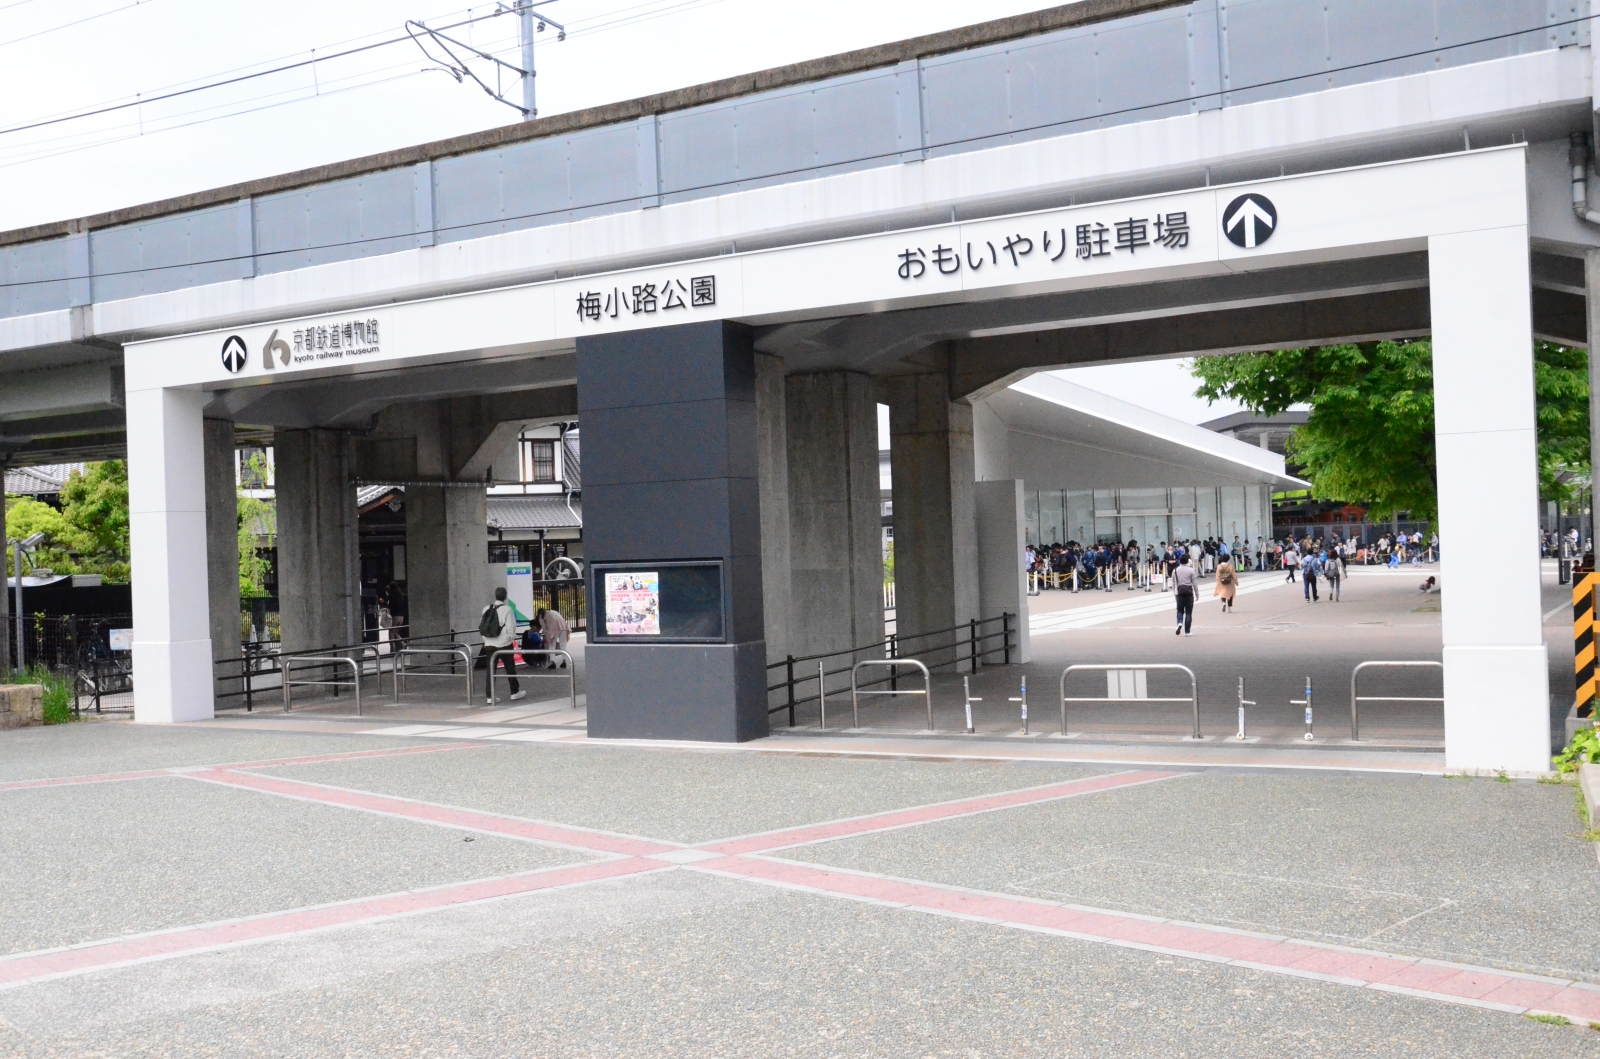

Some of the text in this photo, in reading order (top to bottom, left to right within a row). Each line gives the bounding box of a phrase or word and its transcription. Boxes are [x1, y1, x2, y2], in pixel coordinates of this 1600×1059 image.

[897, 211, 1190, 280] おもいやり駐車場
[576, 274, 716, 322] 梅小路公園
[293, 319, 378, 351] 京都鉄道博物館
[294, 347, 379, 363] kyoto railway museum
